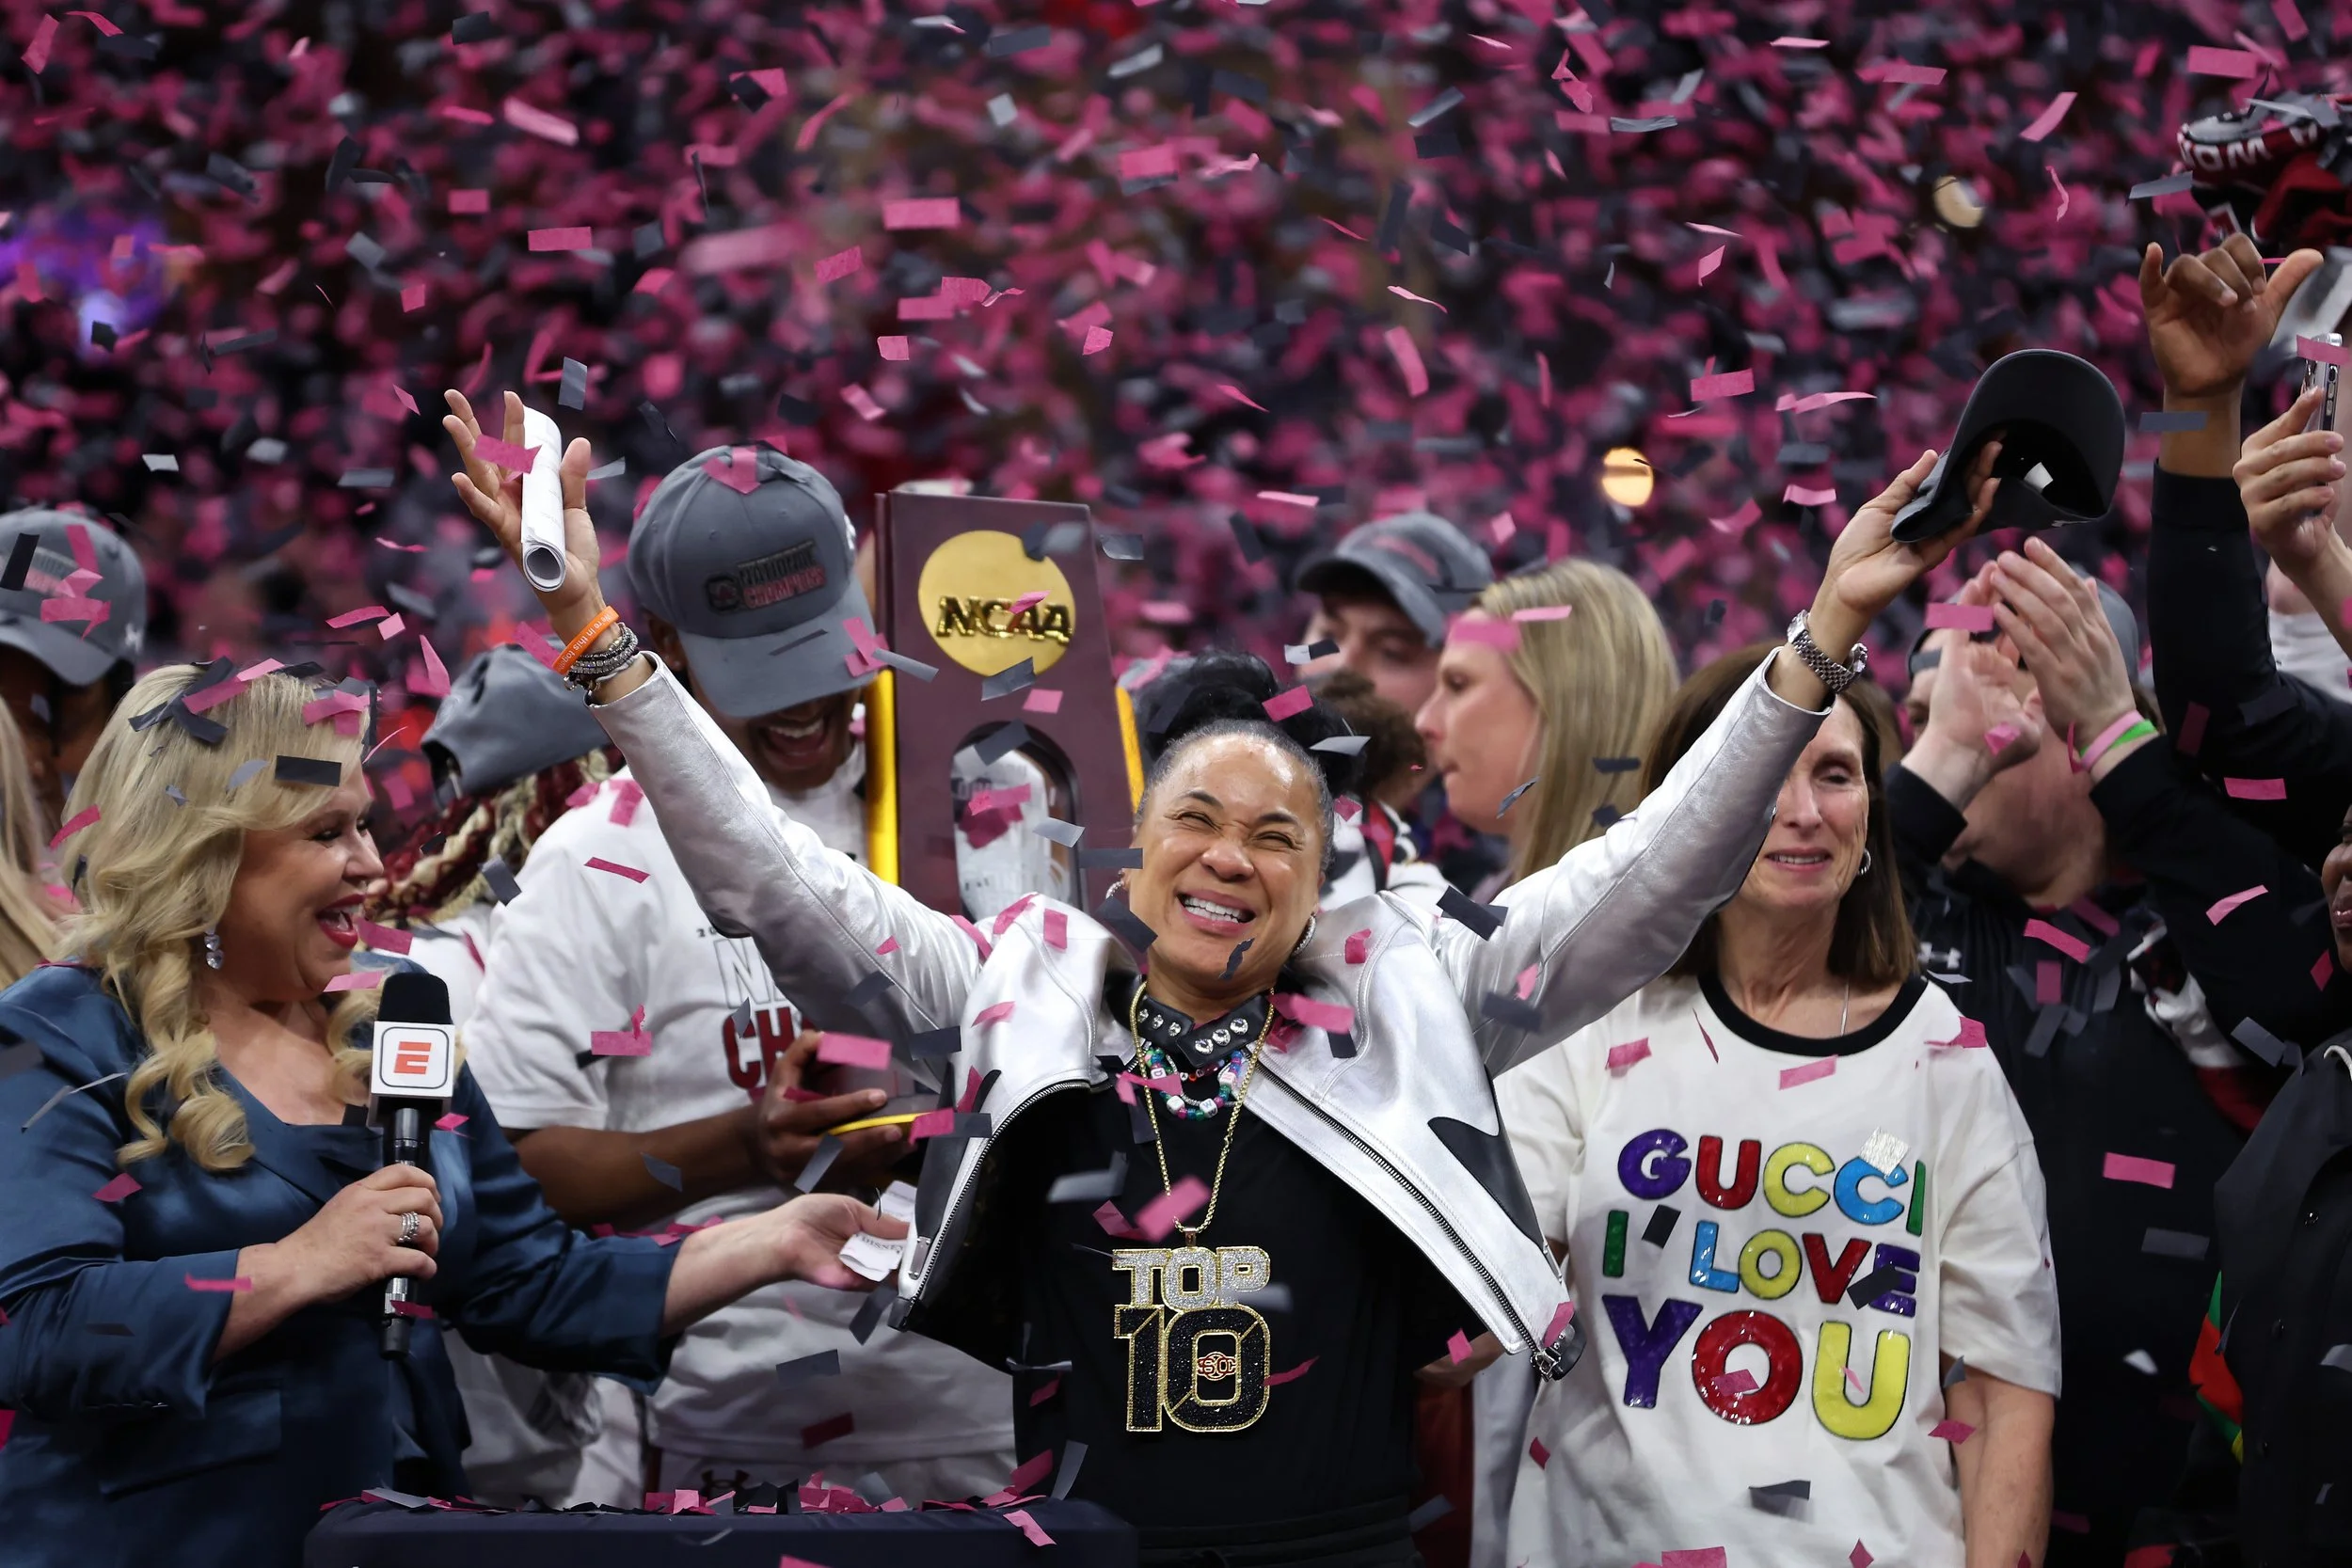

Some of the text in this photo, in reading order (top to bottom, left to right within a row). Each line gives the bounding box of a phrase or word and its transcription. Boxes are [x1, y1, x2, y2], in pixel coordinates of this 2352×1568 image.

[573, 636, 588, 651] this
[586, 626, 596, 637] in
[936, 594, 1073, 646] NCAA
[393, 1041, 432, 1074] E
[1617, 1128, 1927, 1237] GUCCI
[1112, 1246, 1271, 1309] TOP
[1602, 1210, 1921, 1319] I LOVE
[1114, 1304, 1271, 1433] 10
[1601, 1294, 1911, 1441] YOU
